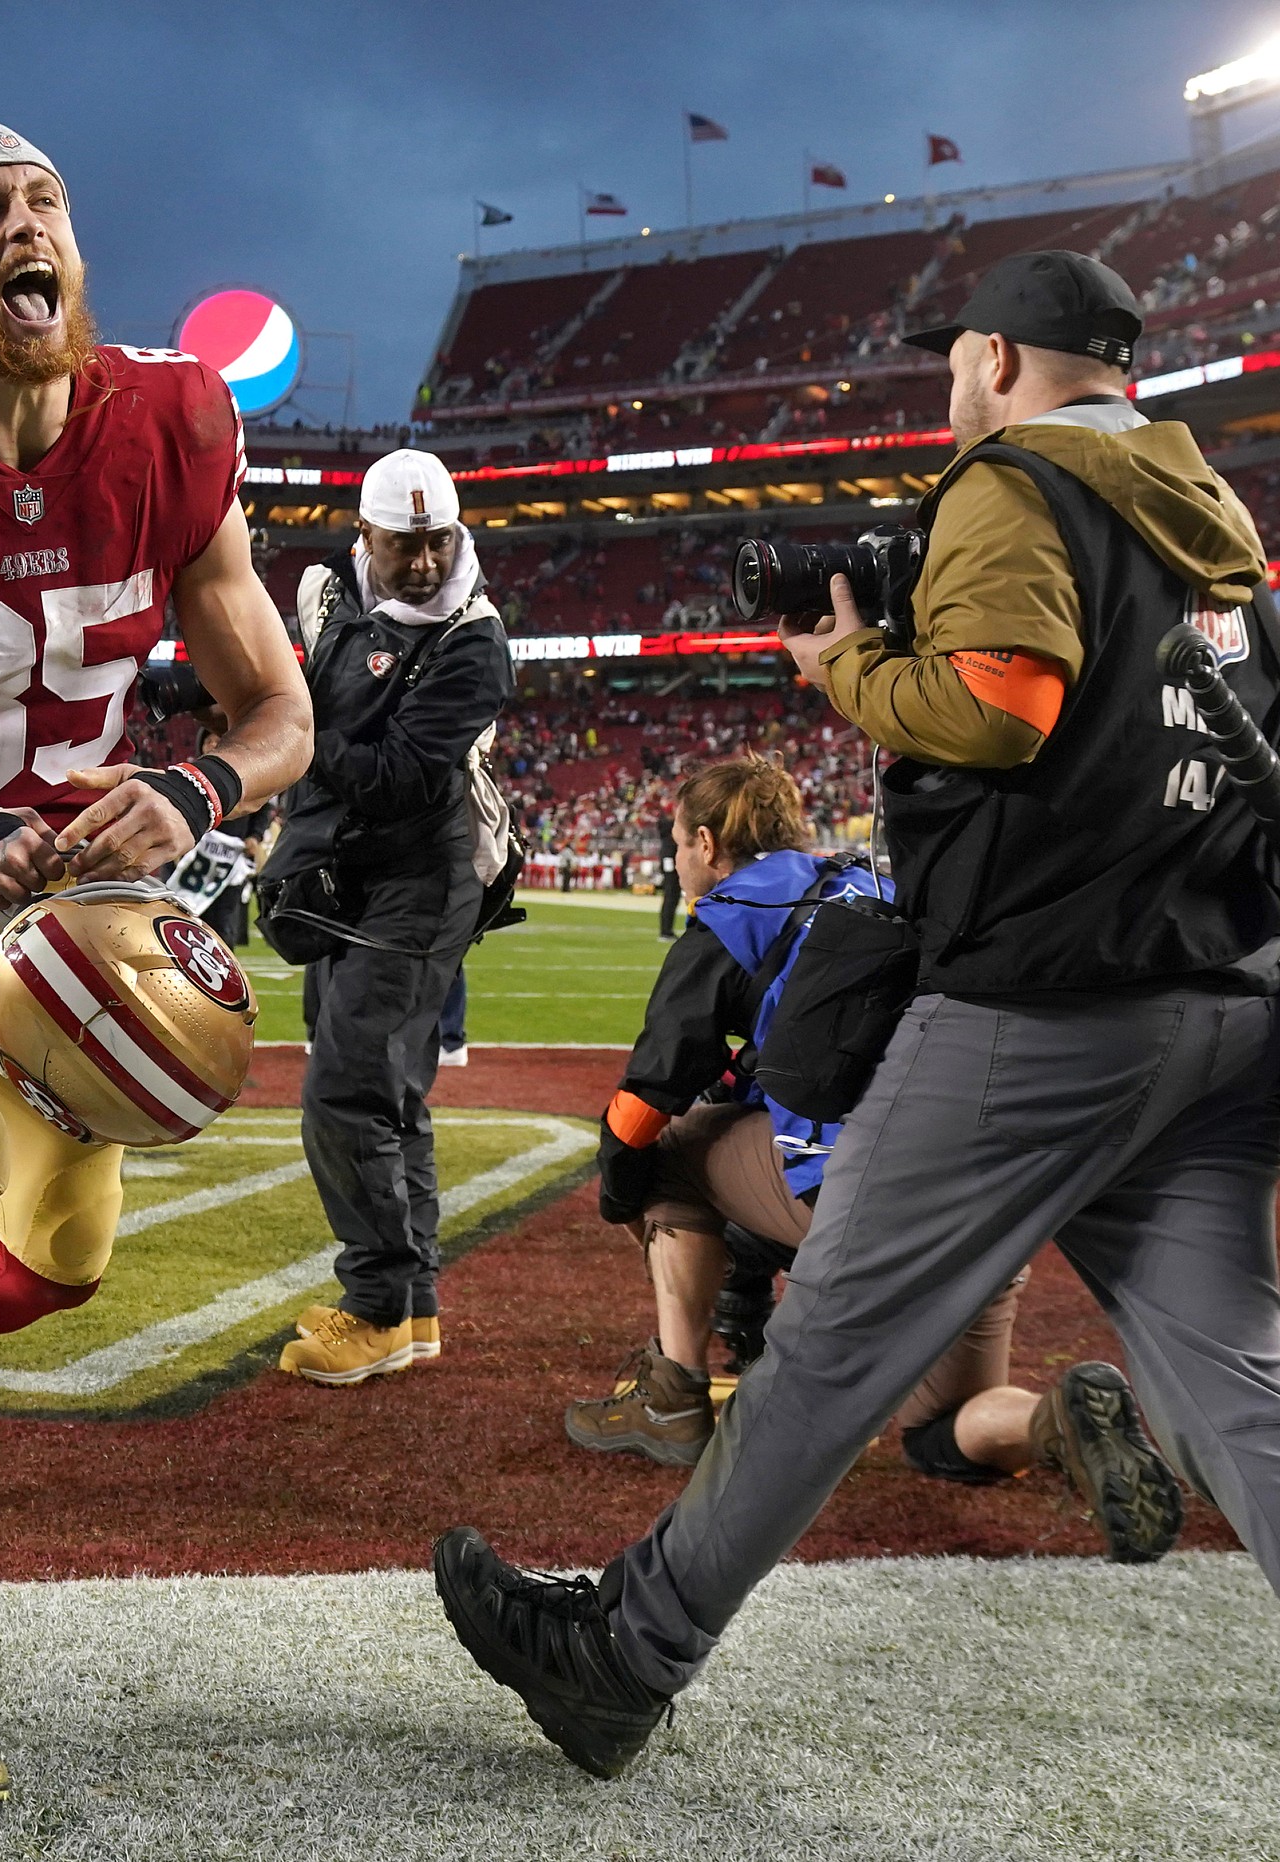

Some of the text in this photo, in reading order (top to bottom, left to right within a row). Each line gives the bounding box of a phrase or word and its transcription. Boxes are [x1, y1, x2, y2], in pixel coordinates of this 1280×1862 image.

[607, 447, 712, 472] NINERS WIN
[285, 468, 322, 485] WIN
[19, 501, 41, 518] NFL
[0, 547, 70, 581] 49ERS
[592, 635, 642, 656] WIN
[179, 851, 233, 898] 83
